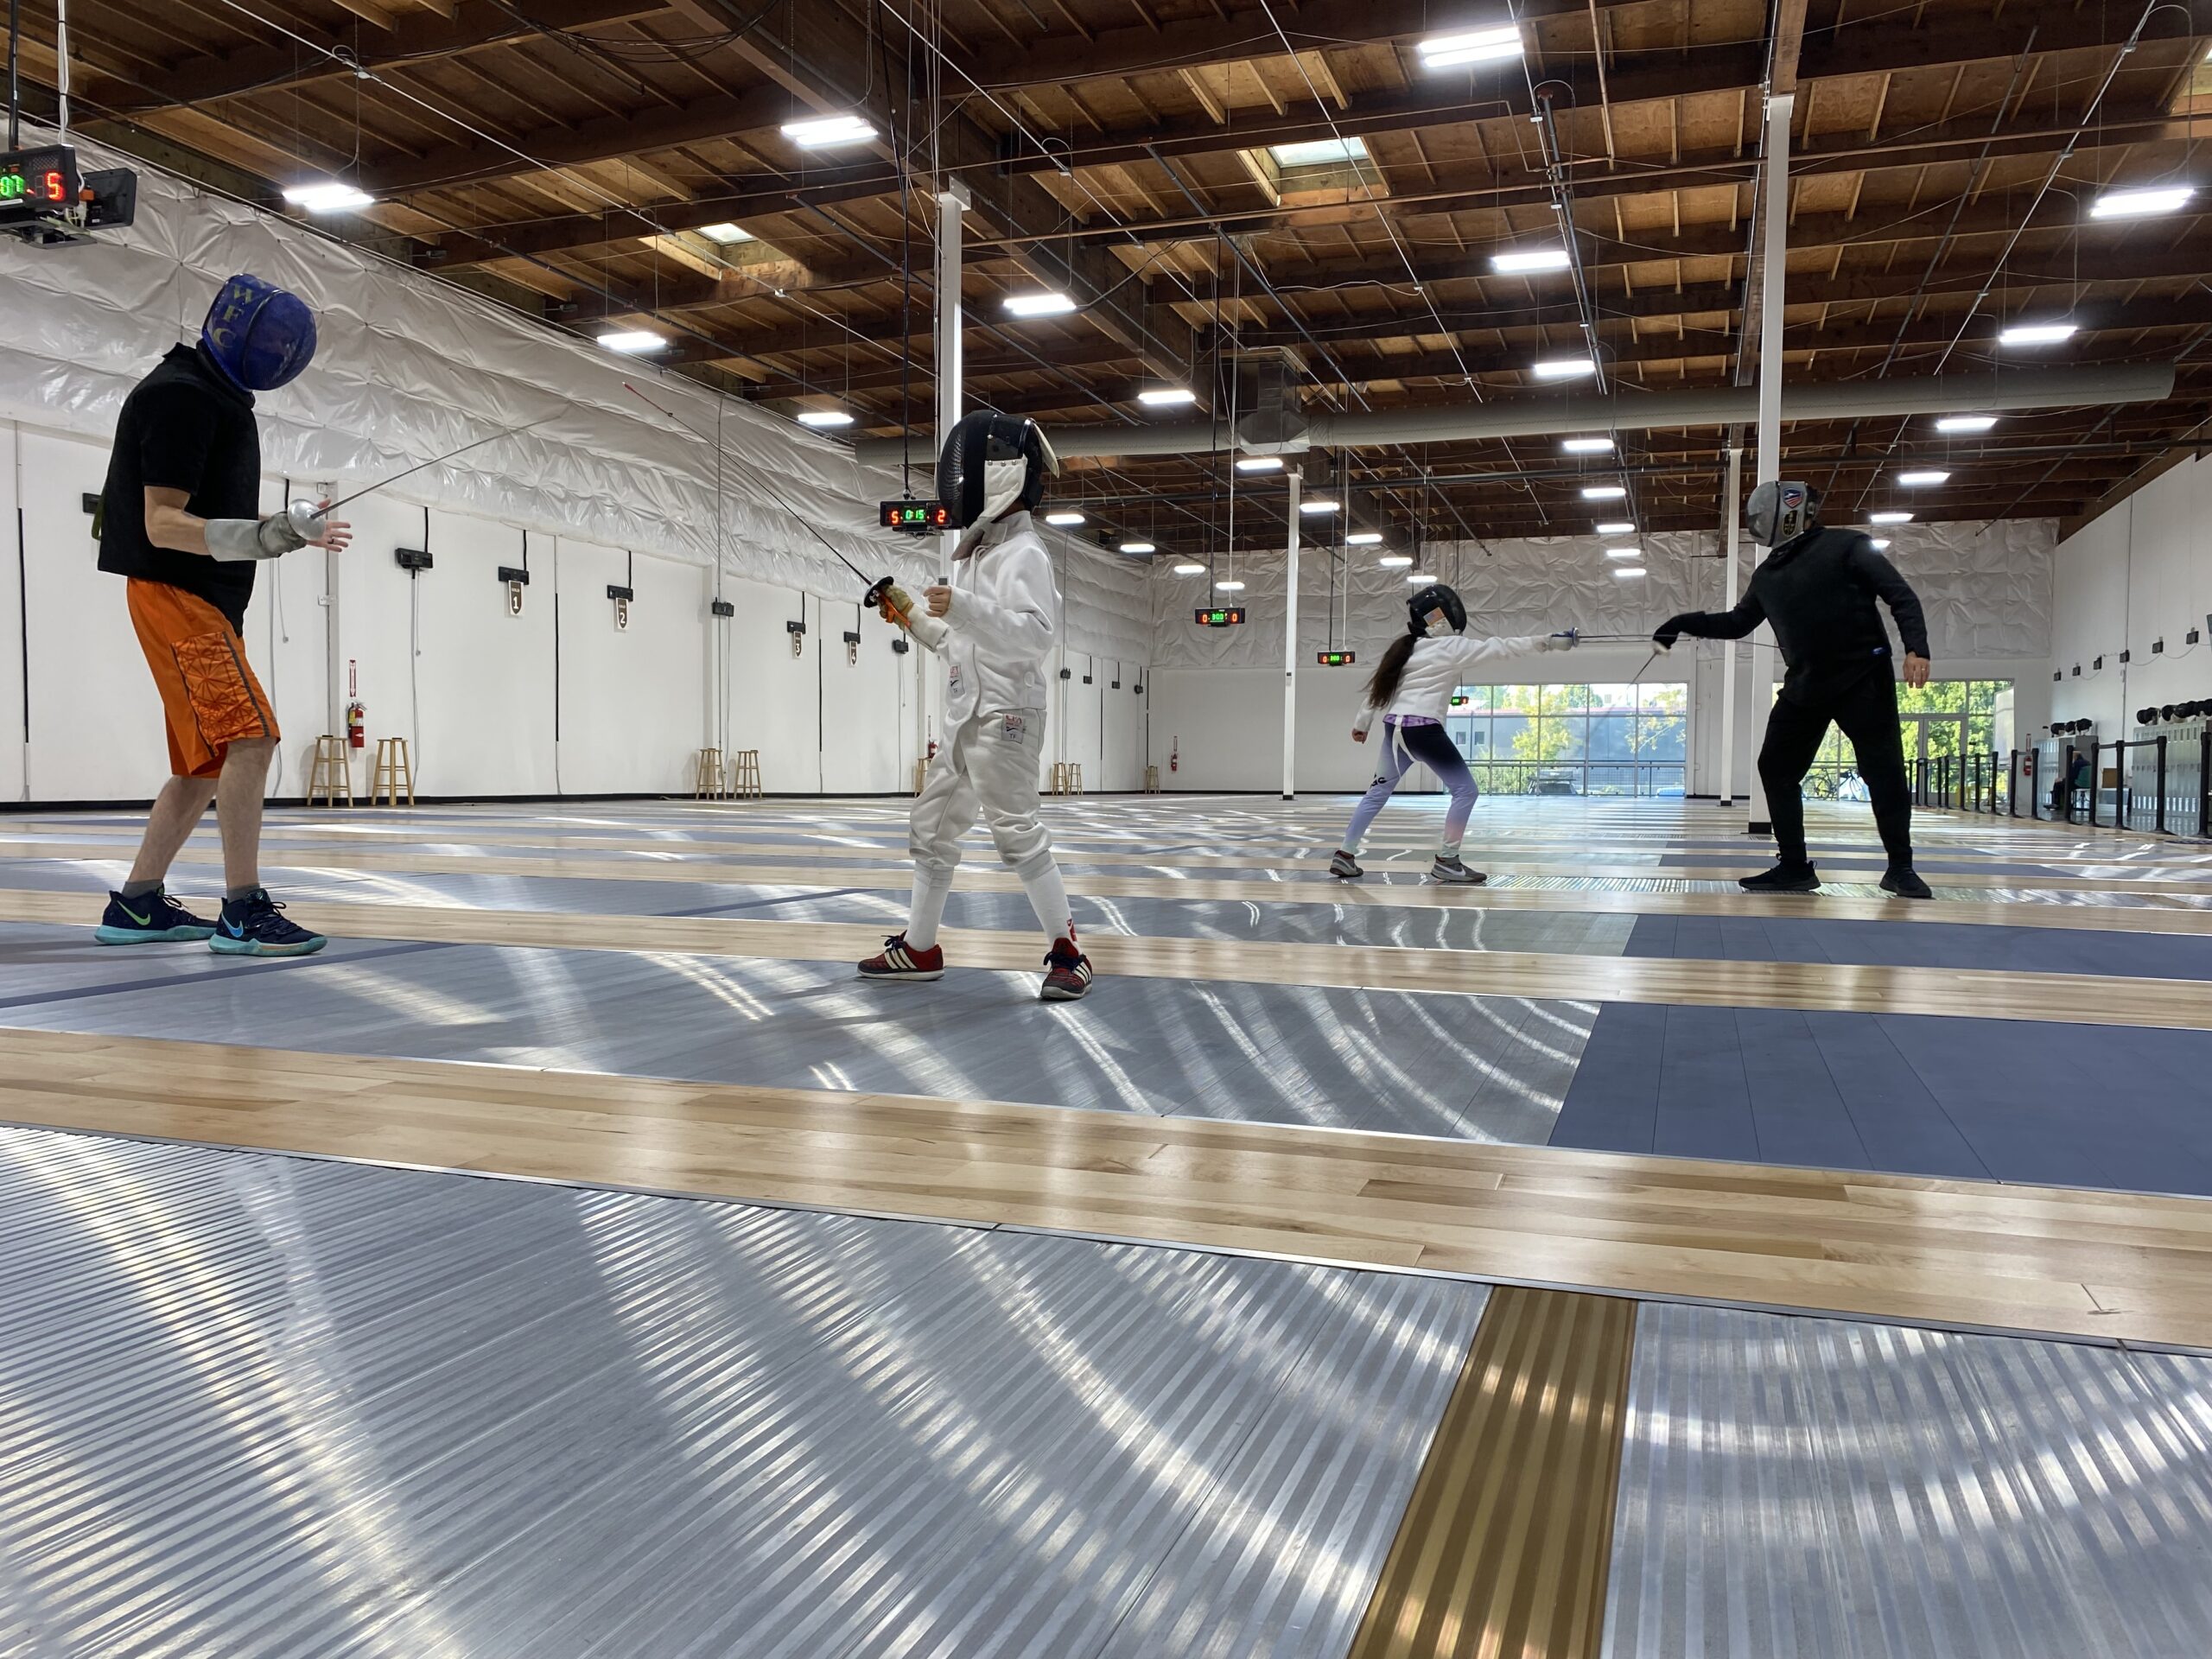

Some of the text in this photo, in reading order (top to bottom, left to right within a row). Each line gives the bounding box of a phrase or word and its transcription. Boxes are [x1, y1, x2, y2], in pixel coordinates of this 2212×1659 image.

[46, 172, 63, 200] 5
[891, 511, 899, 524] 5
[938, 509, 945, 522] 2
[513, 596, 519, 609] 1
[620, 613, 626, 624] 2
[796, 643, 800, 652] 3
